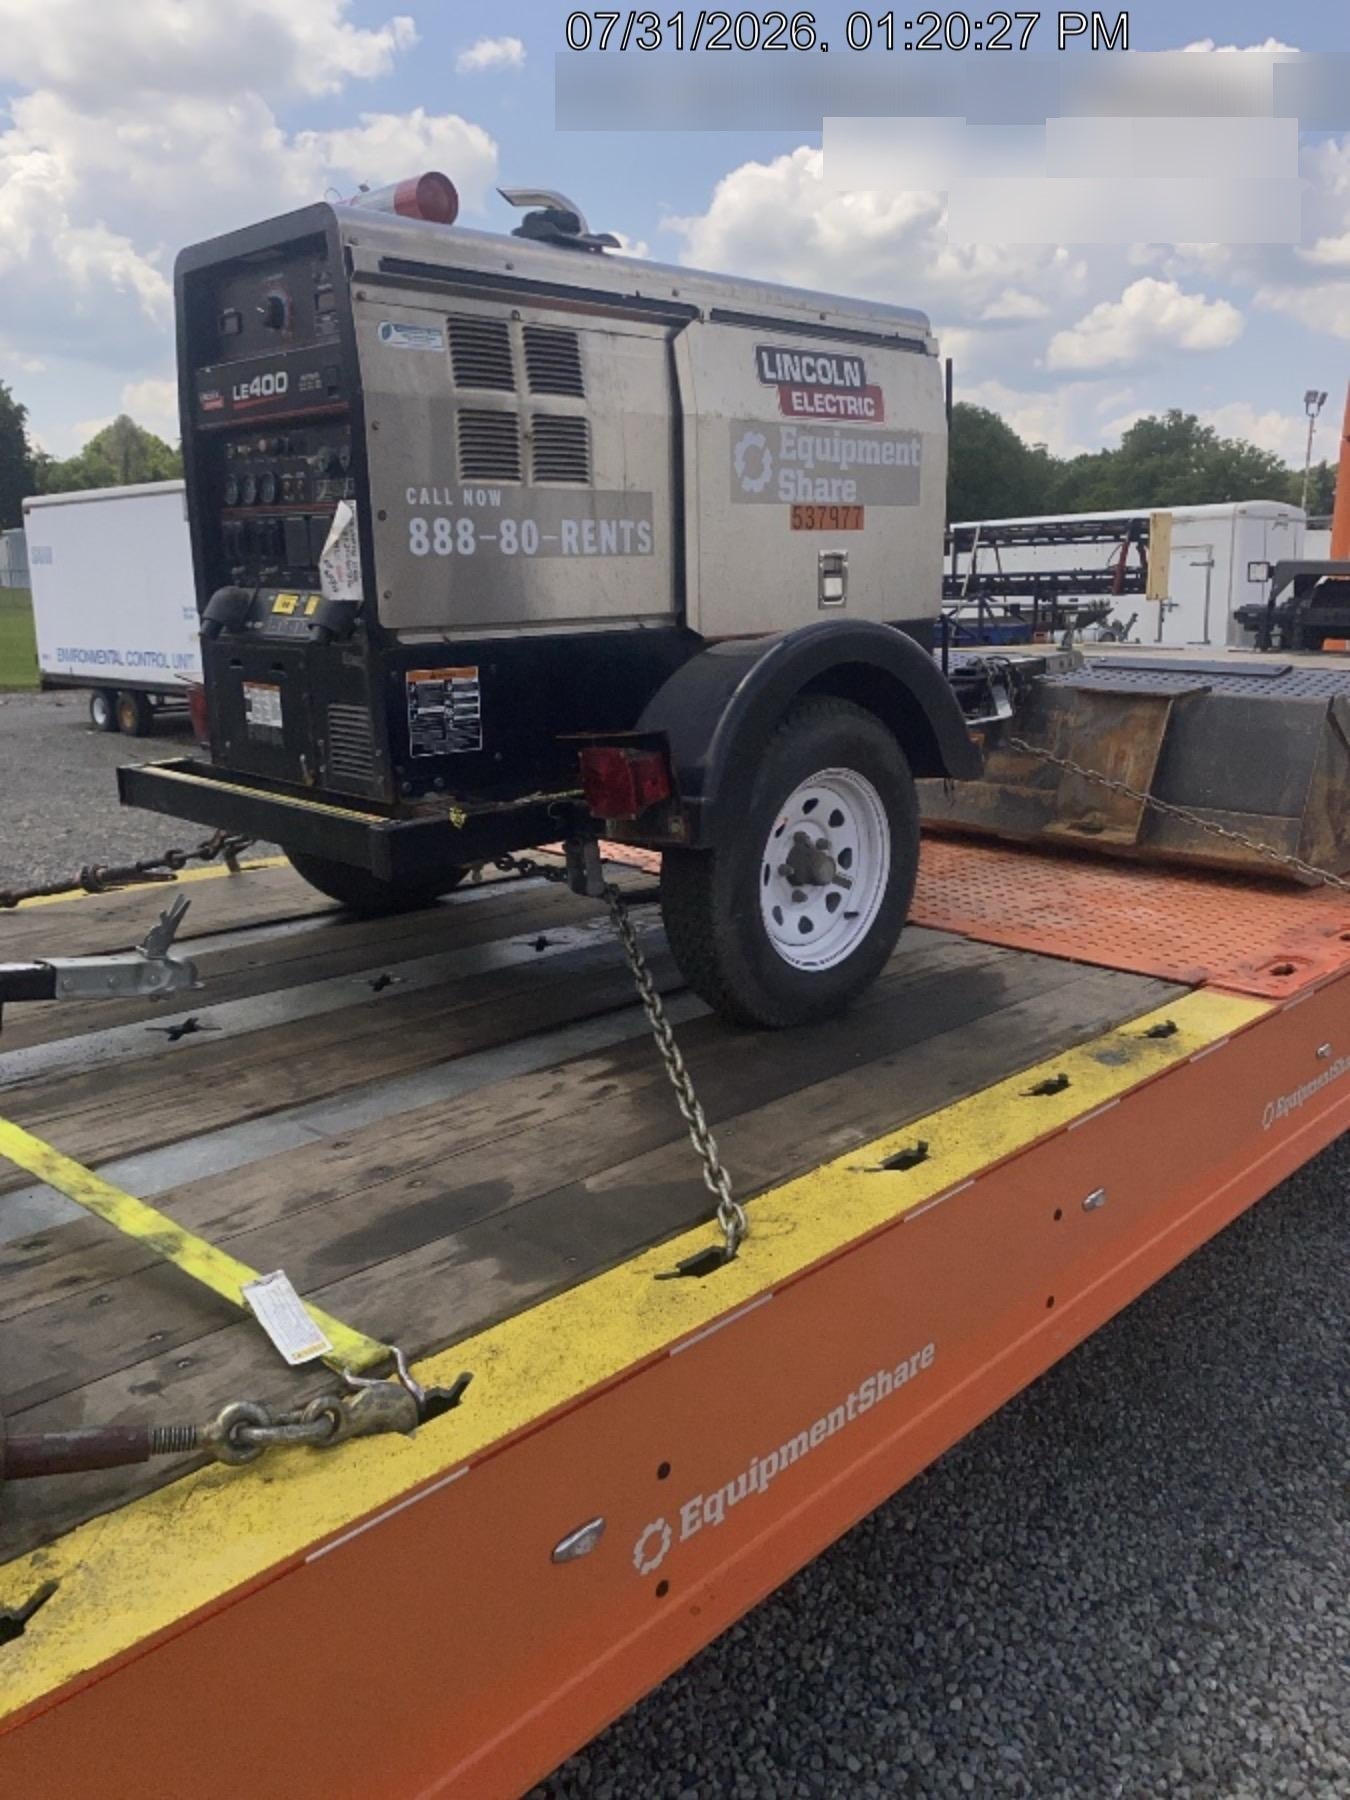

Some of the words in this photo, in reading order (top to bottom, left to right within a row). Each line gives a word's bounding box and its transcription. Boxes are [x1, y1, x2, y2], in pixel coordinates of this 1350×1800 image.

[762, 351, 862, 387] LINCOLN
[232, 371, 289, 401] LE400
[791, 391, 876, 417] ELECTRIC
[779, 425, 921, 471] Equipment
[405, 487, 454, 506] CALL
[463, 488, 502, 507] NOW
[778, 468, 857, 503] Share
[791, 506, 863, 530] 537977
[408, 516, 652, 556] 888-80-RENTS
[126, 651, 171, 669] CONTROL
[172, 653, 196, 669] UNIT
[679, 1342, 936, 1542] EquipmentShare
